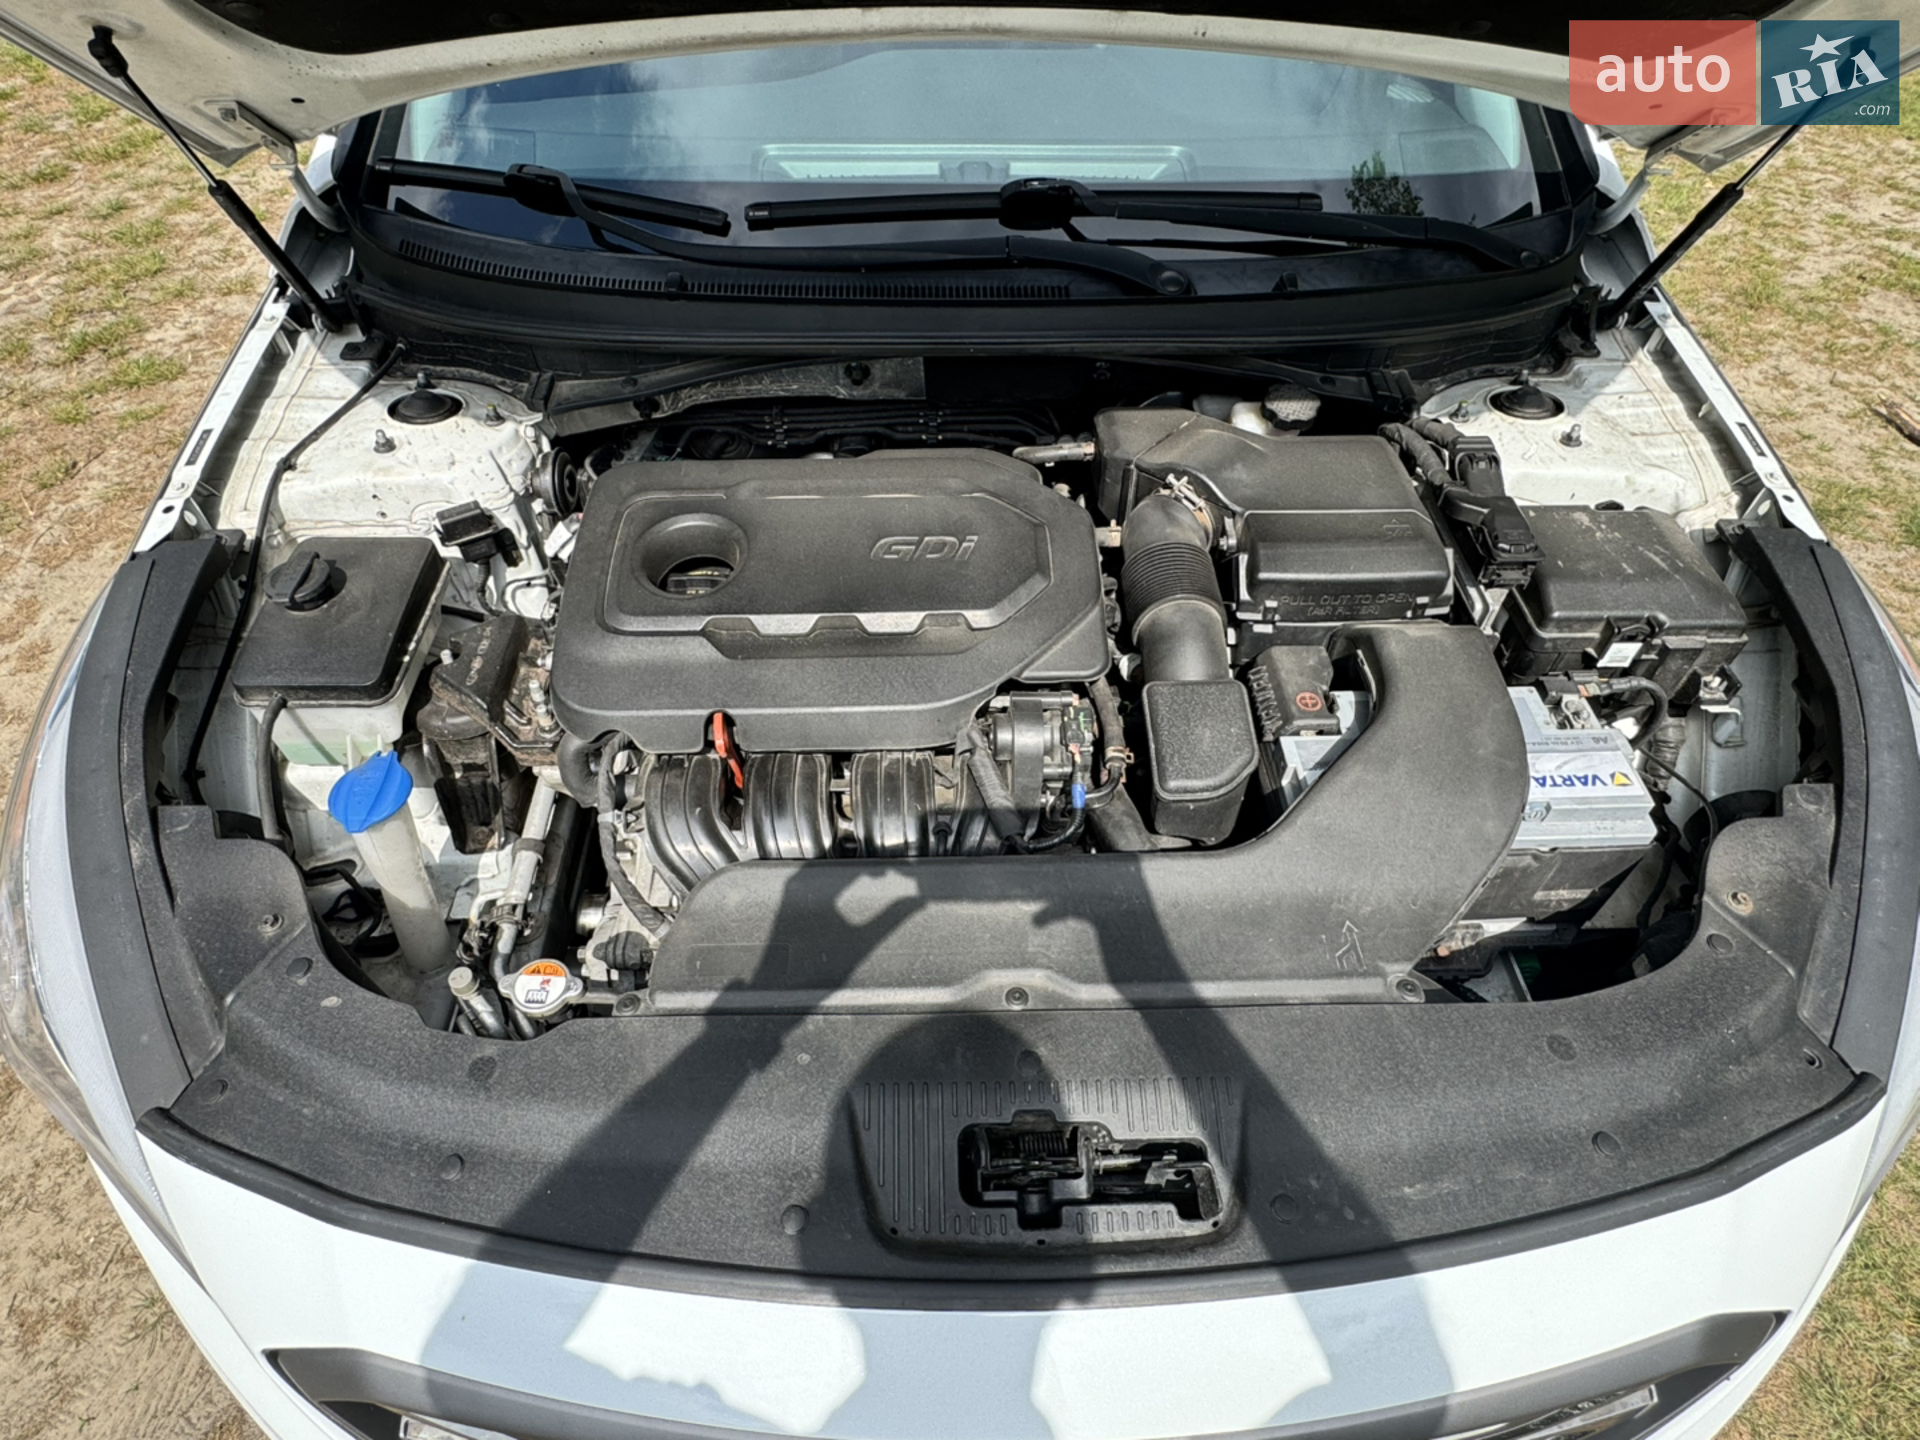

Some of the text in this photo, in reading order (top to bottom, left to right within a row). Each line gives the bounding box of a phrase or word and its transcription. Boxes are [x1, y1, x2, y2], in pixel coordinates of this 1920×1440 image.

[870, 535, 979, 562] GDi
[1280, 593, 1415, 606] PULL OUT TO OPEN
[1530, 773, 1608, 788] VARTA
